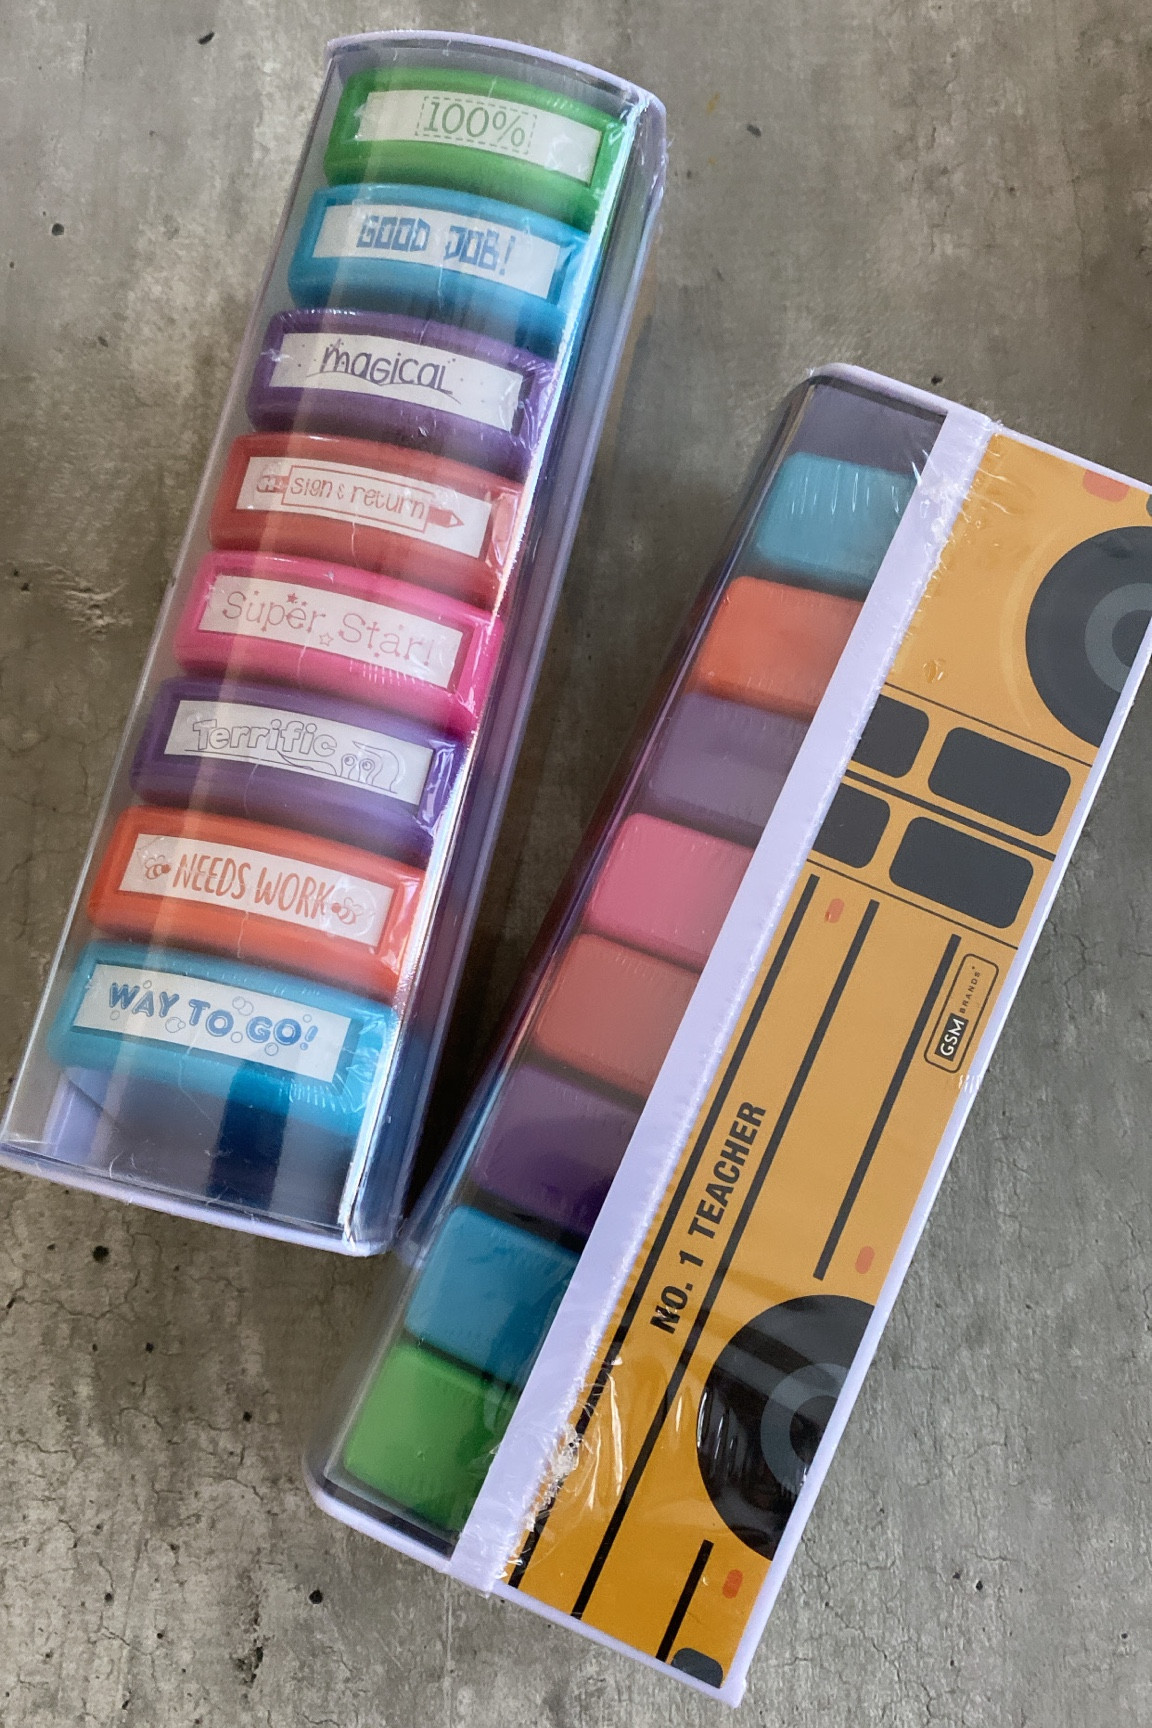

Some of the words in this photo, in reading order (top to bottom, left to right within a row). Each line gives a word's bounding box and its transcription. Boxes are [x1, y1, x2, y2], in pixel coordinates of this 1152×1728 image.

[421, 101, 526, 147] 100%
[356, 214, 431, 252] GOOD
[443, 225, 517, 276] JOB!
[350, 485, 425, 519] return
[222, 589, 326, 633] Super
[192, 718, 338, 758] Terrific
[172, 853, 252, 901] NEEDS
[255, 868, 335, 919] WORK
[109, 980, 182, 1019] WAY
[187, 998, 235, 1038] TO
[245, 1015, 319, 1052] GO!
[940, 1018, 965, 1056] GSM
[959, 971, 981, 1014] BRANDS
[687, 1100, 767, 1239] TEACHER
[679, 1250, 704, 1267] 1
[649, 1283, 694, 1335] NO.
